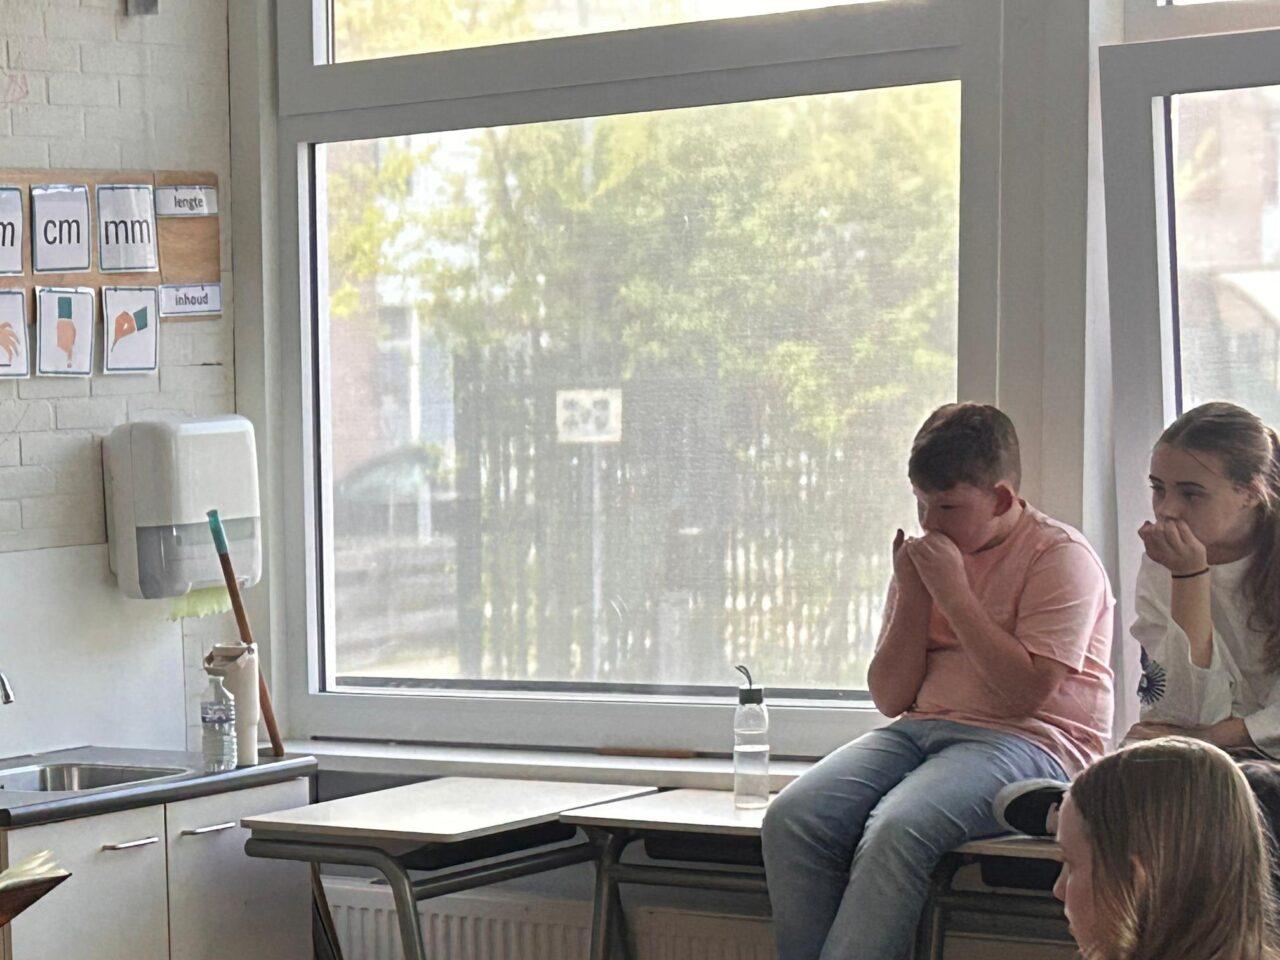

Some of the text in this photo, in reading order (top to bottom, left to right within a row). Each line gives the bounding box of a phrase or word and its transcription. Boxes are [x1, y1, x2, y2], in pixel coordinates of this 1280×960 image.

[174, 196, 203, 211] lengte
[43, 218, 81, 245] cm
[104, 218, 151, 245] mm
[175, 292, 209, 306] inhoud
